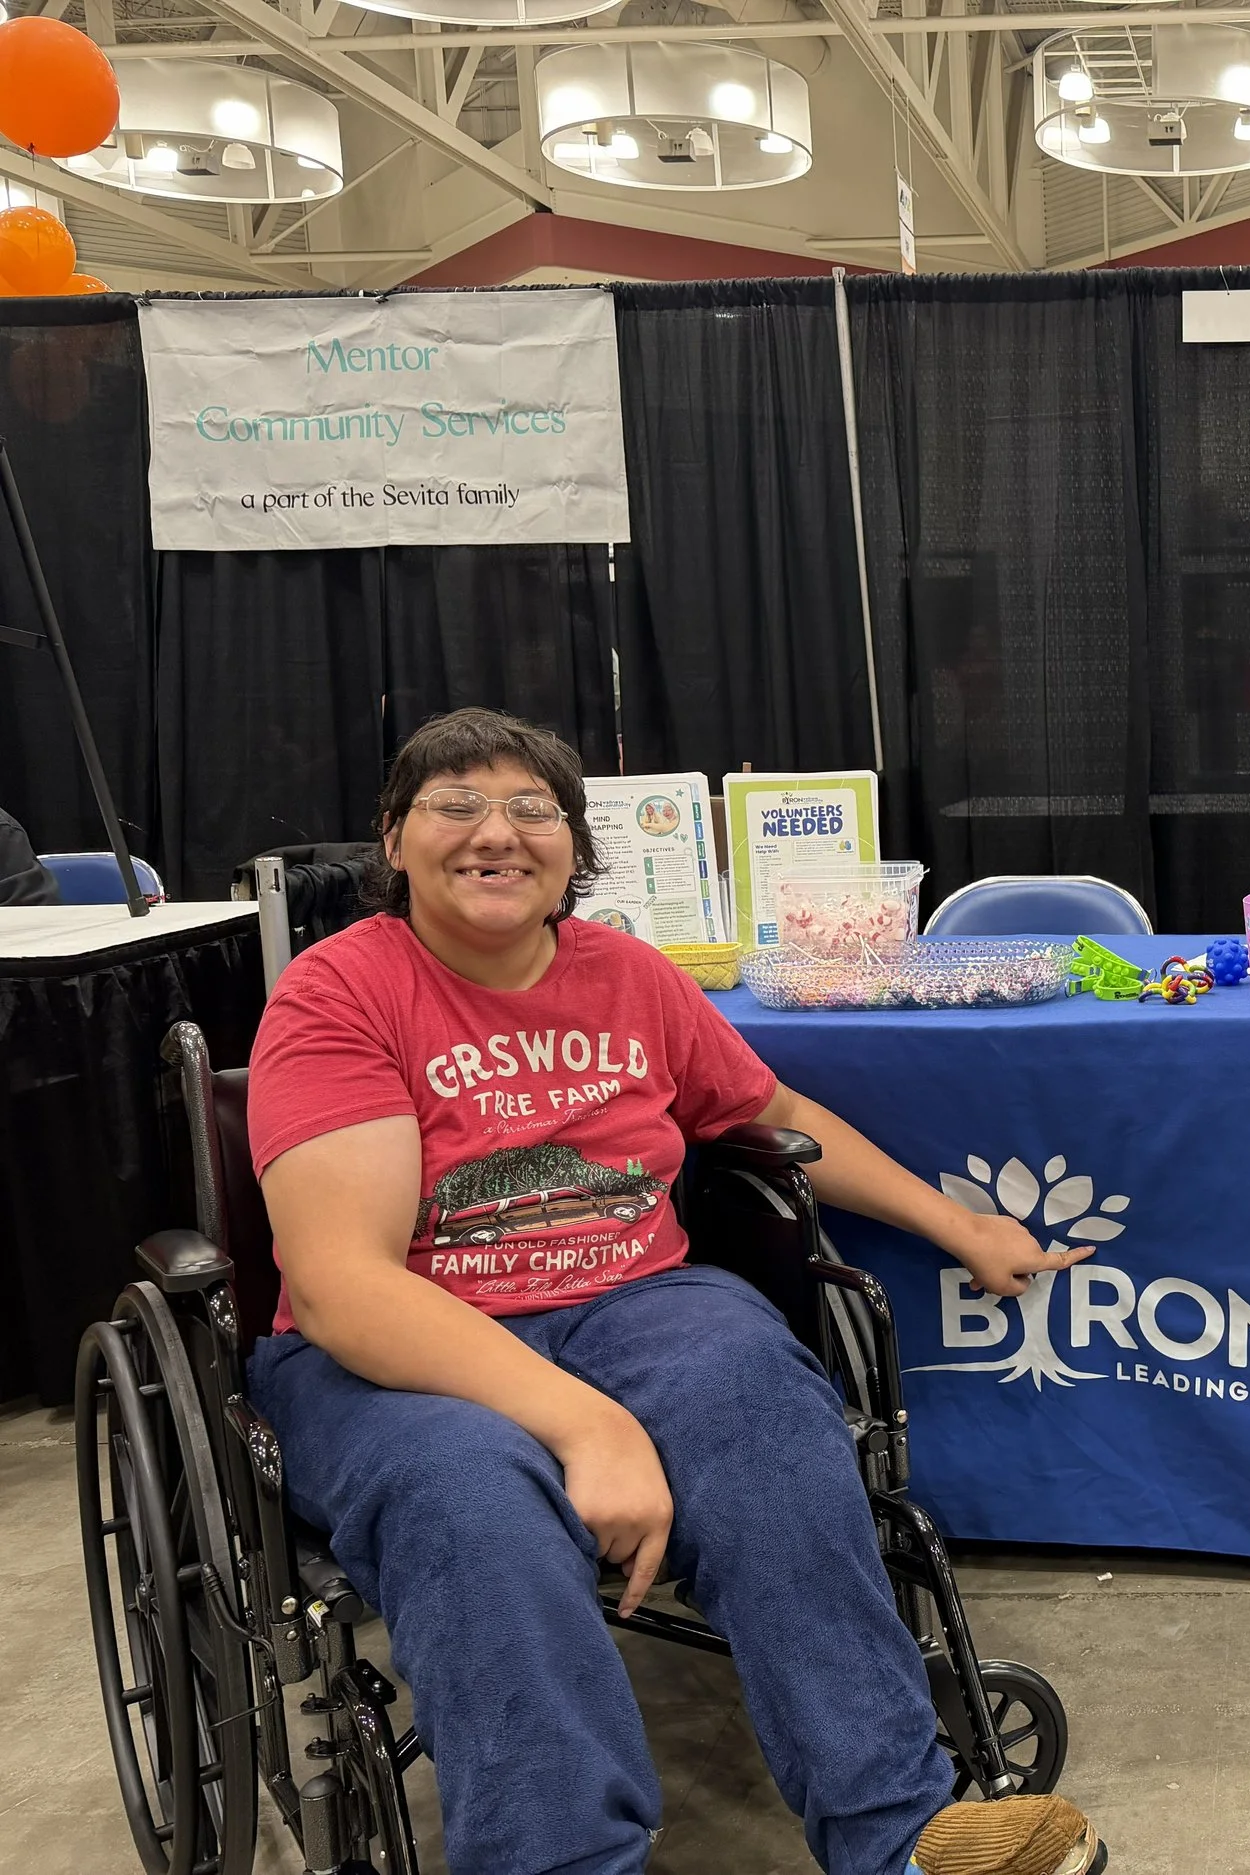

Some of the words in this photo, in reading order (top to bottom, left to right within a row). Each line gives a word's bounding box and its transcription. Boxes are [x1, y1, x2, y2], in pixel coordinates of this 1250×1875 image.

[306, 337, 439, 374] Mentor
[196, 402, 405, 447] Community
[420, 397, 567, 438] Services
[241, 493, 255, 509] a
[263, 492, 309, 513] part
[314, 486, 337, 508] of
[341, 485, 375, 508] the
[383, 483, 448, 506] Sevita
[456, 482, 520, 508] family
[592, 815, 611, 823] MIND
[761, 804, 843, 820] VOLUNTEERS
[591, 823, 624, 831] MAPPING
[762, 816, 844, 837] NEEDED
[642, 846, 676, 854] OBJECTIVES
[472, 1089, 537, 1120] TREE
[547, 1079, 622, 1111] FARM
[483, 1125, 494, 1134] a
[496, 1119, 559, 1134] Christmas
[517, 1240, 547, 1250] OLD
[430, 1252, 520, 1276] FAMILY
[1116, 1361, 1249, 1402] LEADING
